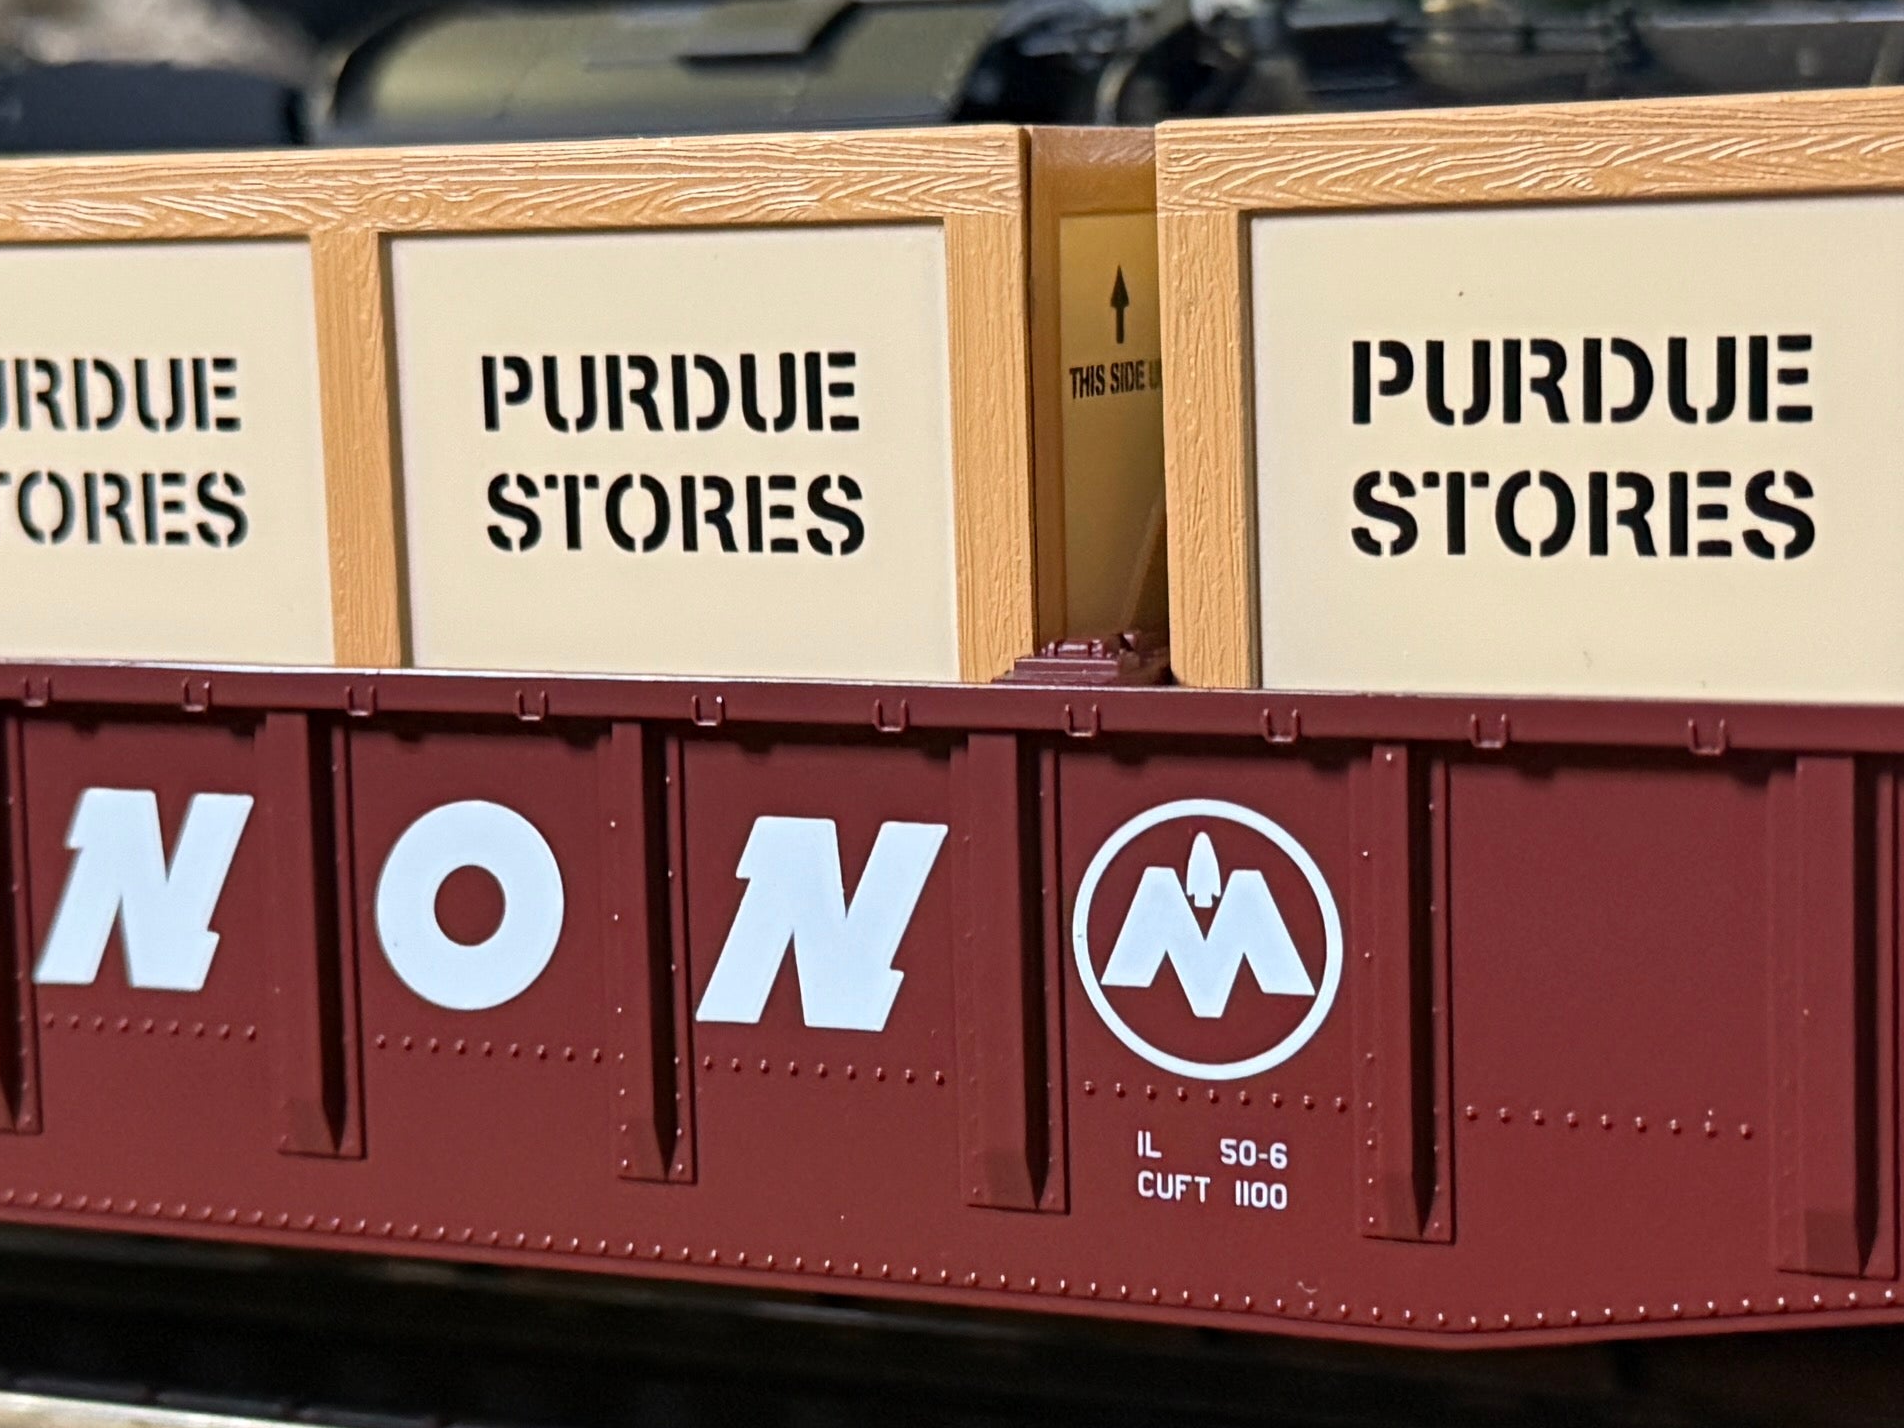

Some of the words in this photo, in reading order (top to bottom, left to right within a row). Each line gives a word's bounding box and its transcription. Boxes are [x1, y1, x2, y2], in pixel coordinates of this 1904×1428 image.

[481, 350, 860, 433] PURDUE
[1069, 364, 1105, 399] THIS
[1110, 359, 1145, 394] SIDE
[1352, 333, 1814, 426] PURDUE
[486, 472, 865, 556] STORES
[1350, 469, 1816, 560] STORES
[1137, 1130, 1162, 1158] IL
[1220, 1138, 1288, 1170] 50-6
[1138, 1170, 1211, 1203] CUFT
[1235, 1180, 1288, 1210] 1100
